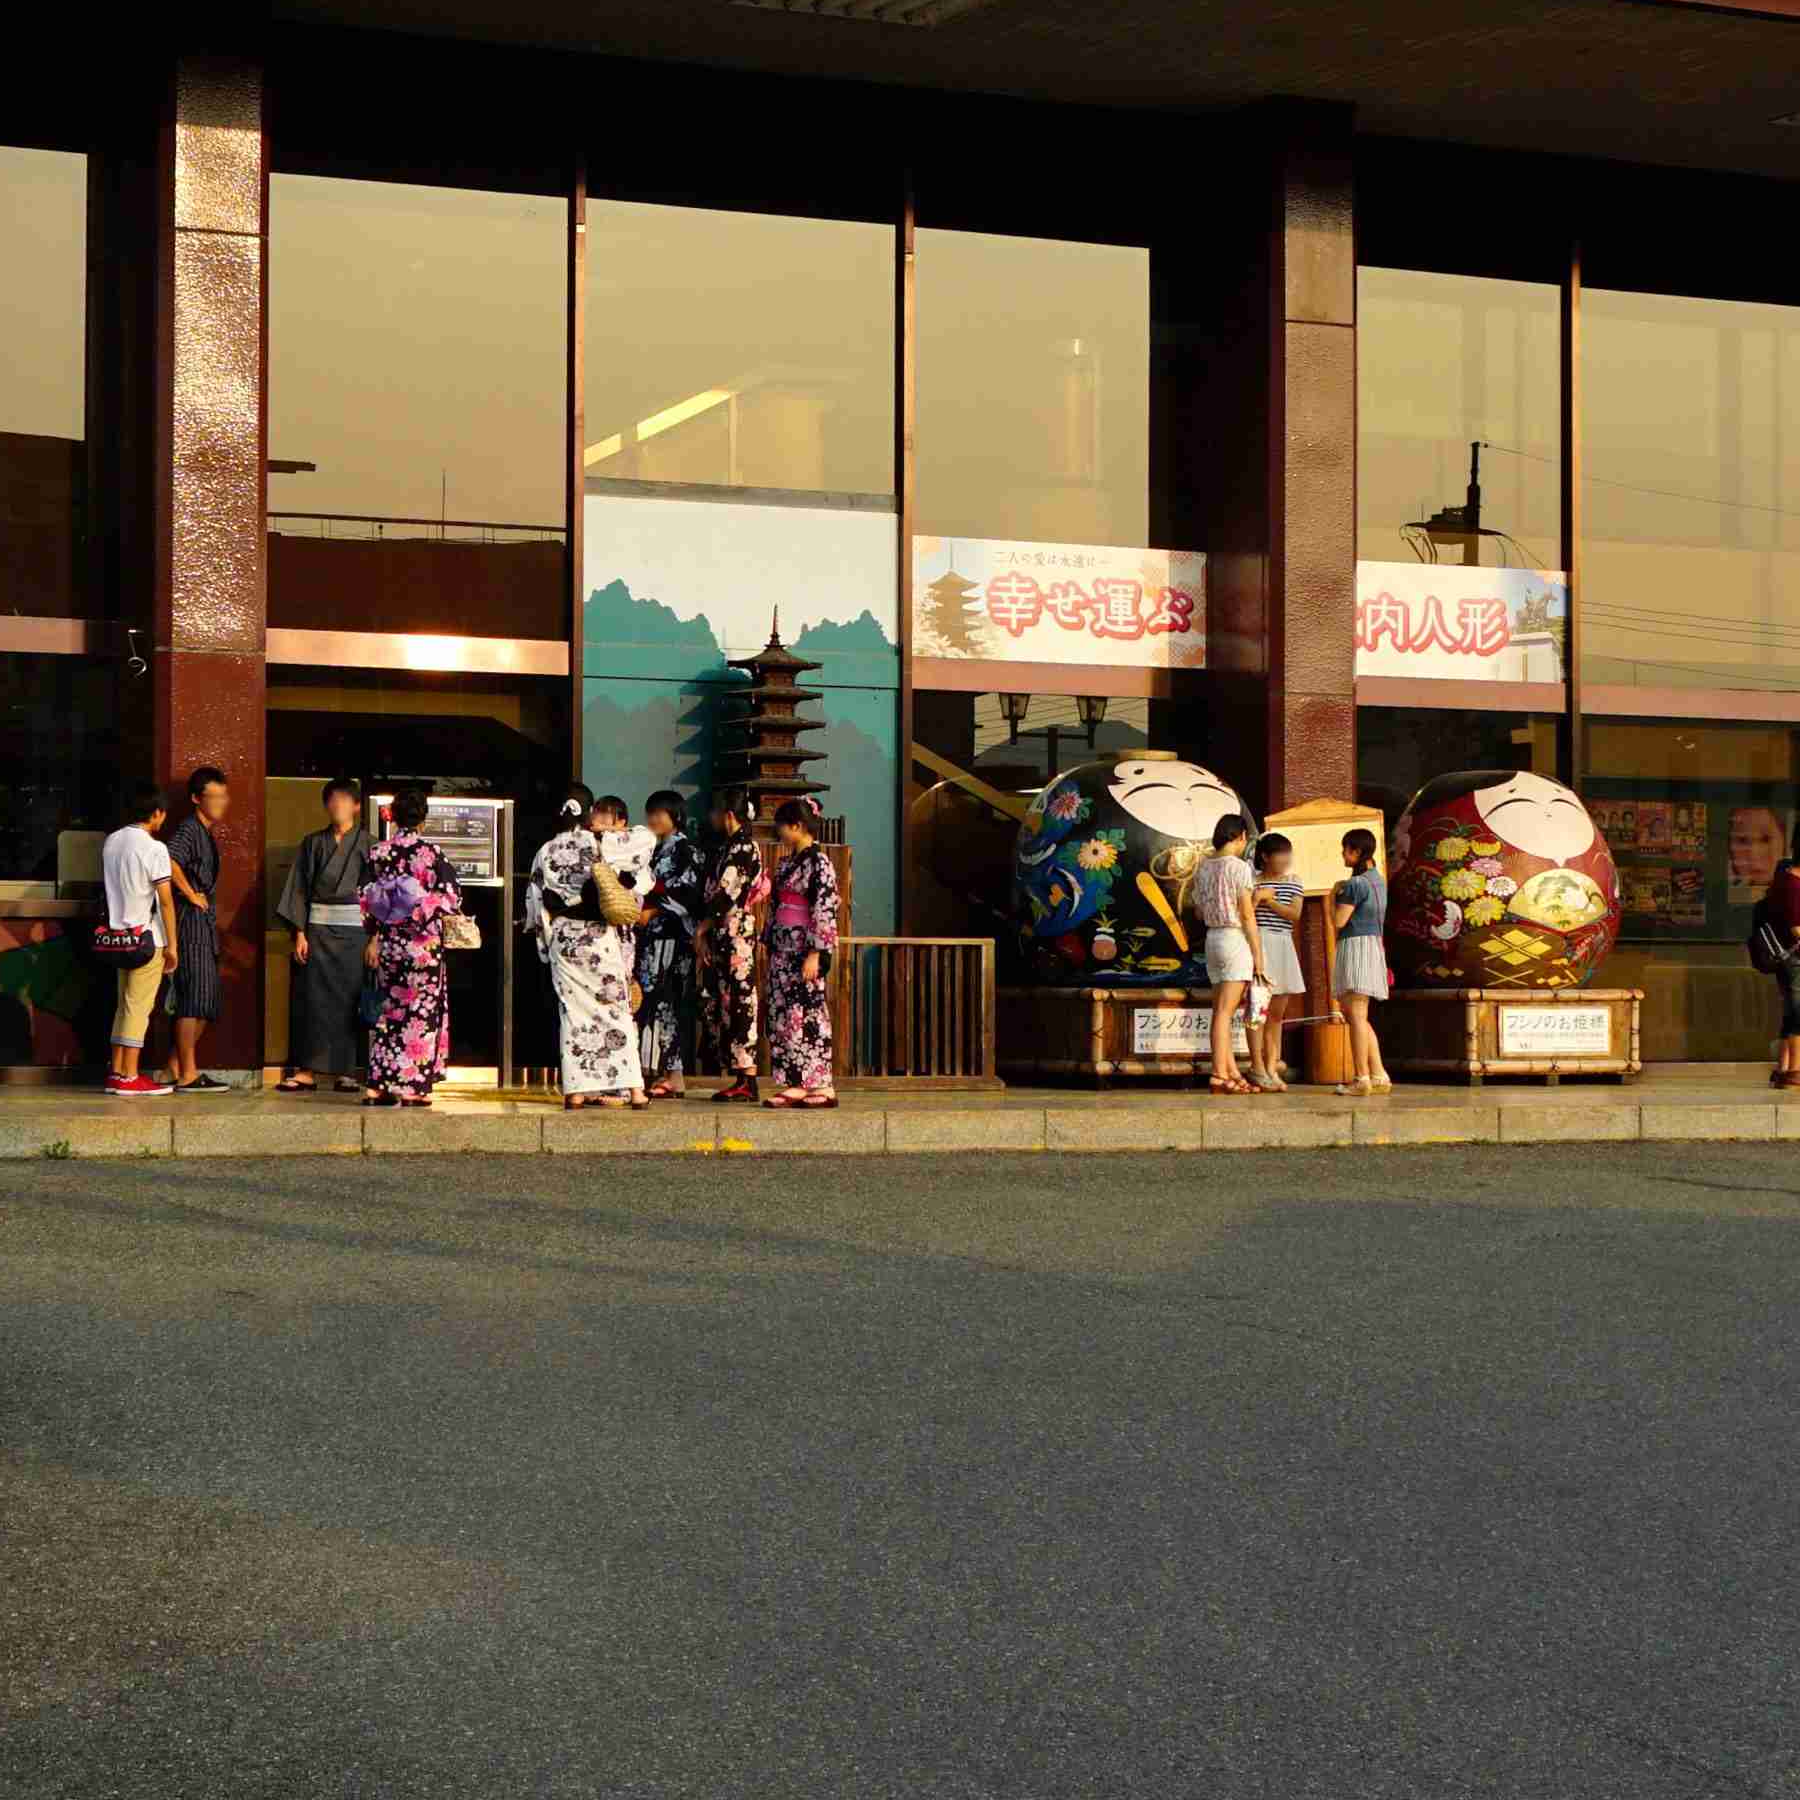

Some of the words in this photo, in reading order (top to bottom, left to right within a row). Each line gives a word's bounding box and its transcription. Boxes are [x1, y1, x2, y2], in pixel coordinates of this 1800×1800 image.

[986, 571, 1194, 640] 幸せ運ぶ
[1354, 592, 1512, 657] 内人形
[96, 935, 141, 945] TOMMY
